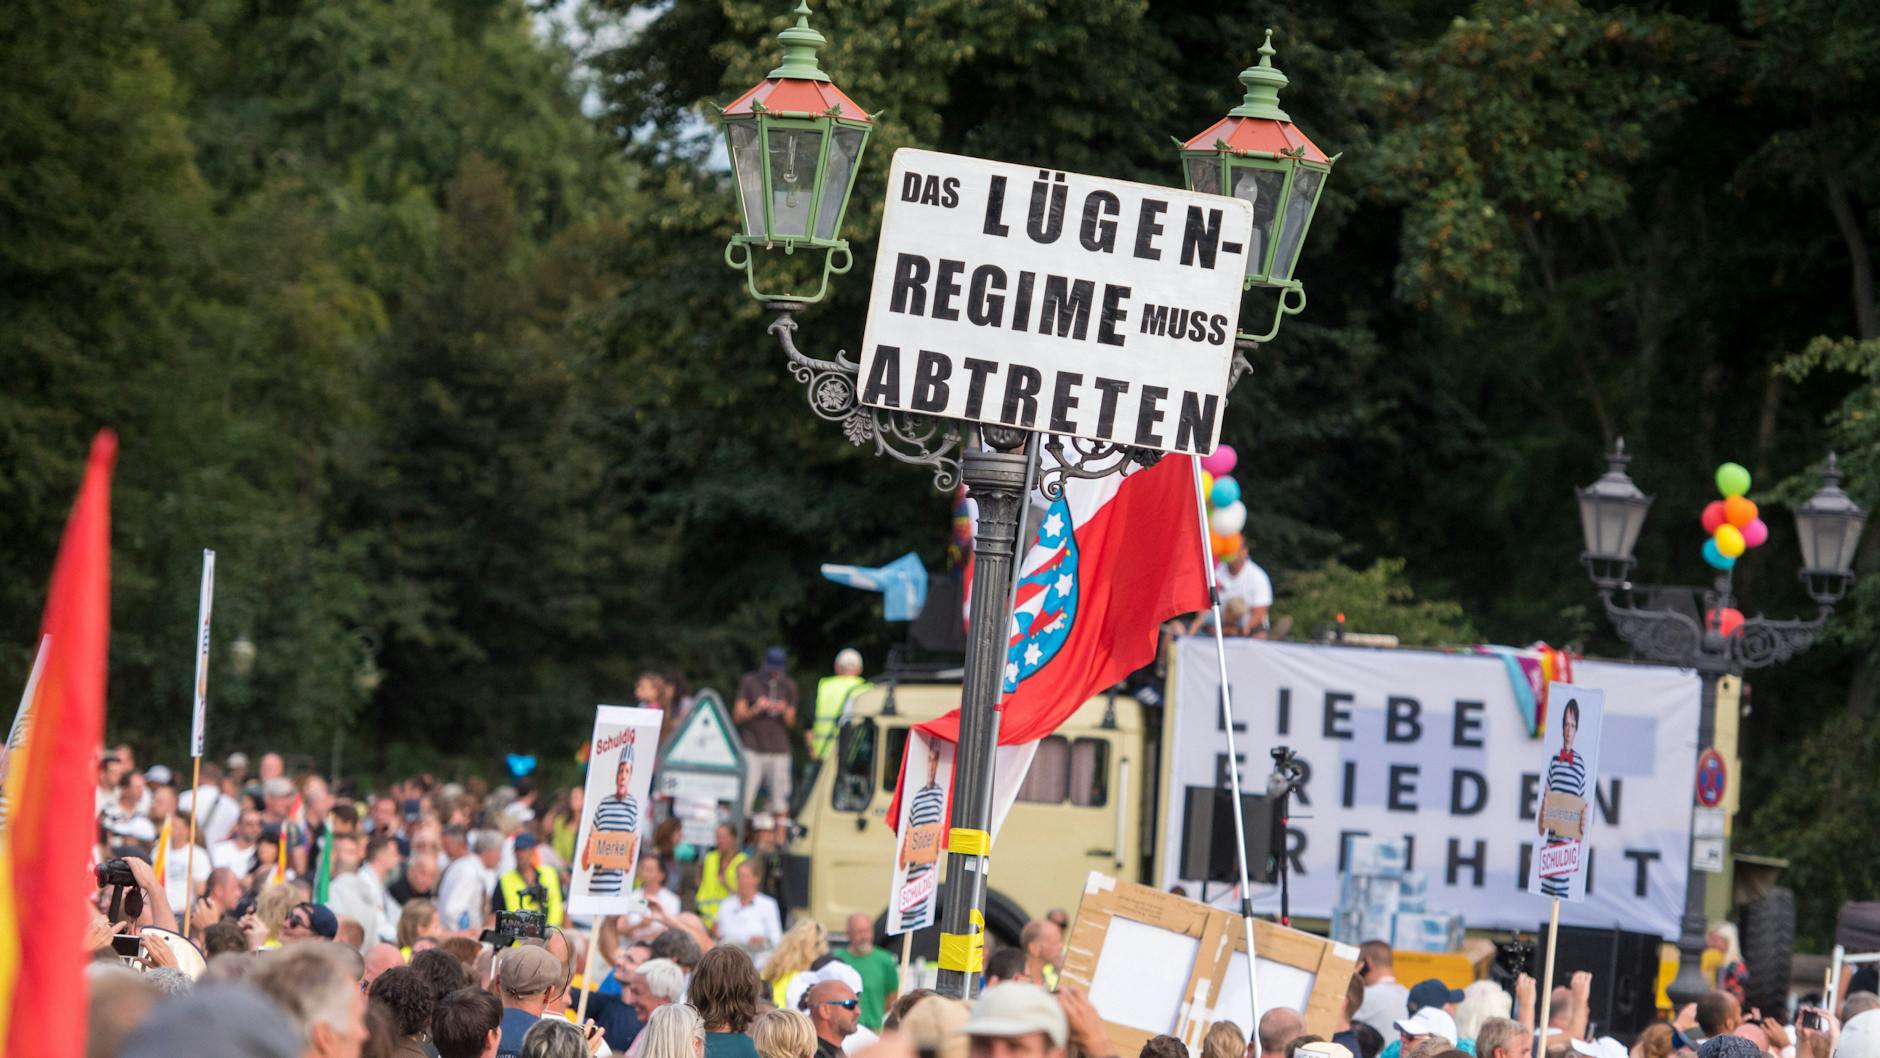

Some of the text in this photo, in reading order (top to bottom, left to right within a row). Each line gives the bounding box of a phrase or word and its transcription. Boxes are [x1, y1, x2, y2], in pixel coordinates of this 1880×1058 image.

[901, 170, 1243, 270] DAS LÜGEN-
[889, 252, 1229, 347] REGIME MUSS
[863, 344, 1219, 455] ABTRETEN
[596, 727, 636, 754] Schuldig
[1217, 683, 1485, 748] LIEBE
[596, 838, 629, 857] Merkel
[1541, 847, 1577, 871] SCHULDIG
